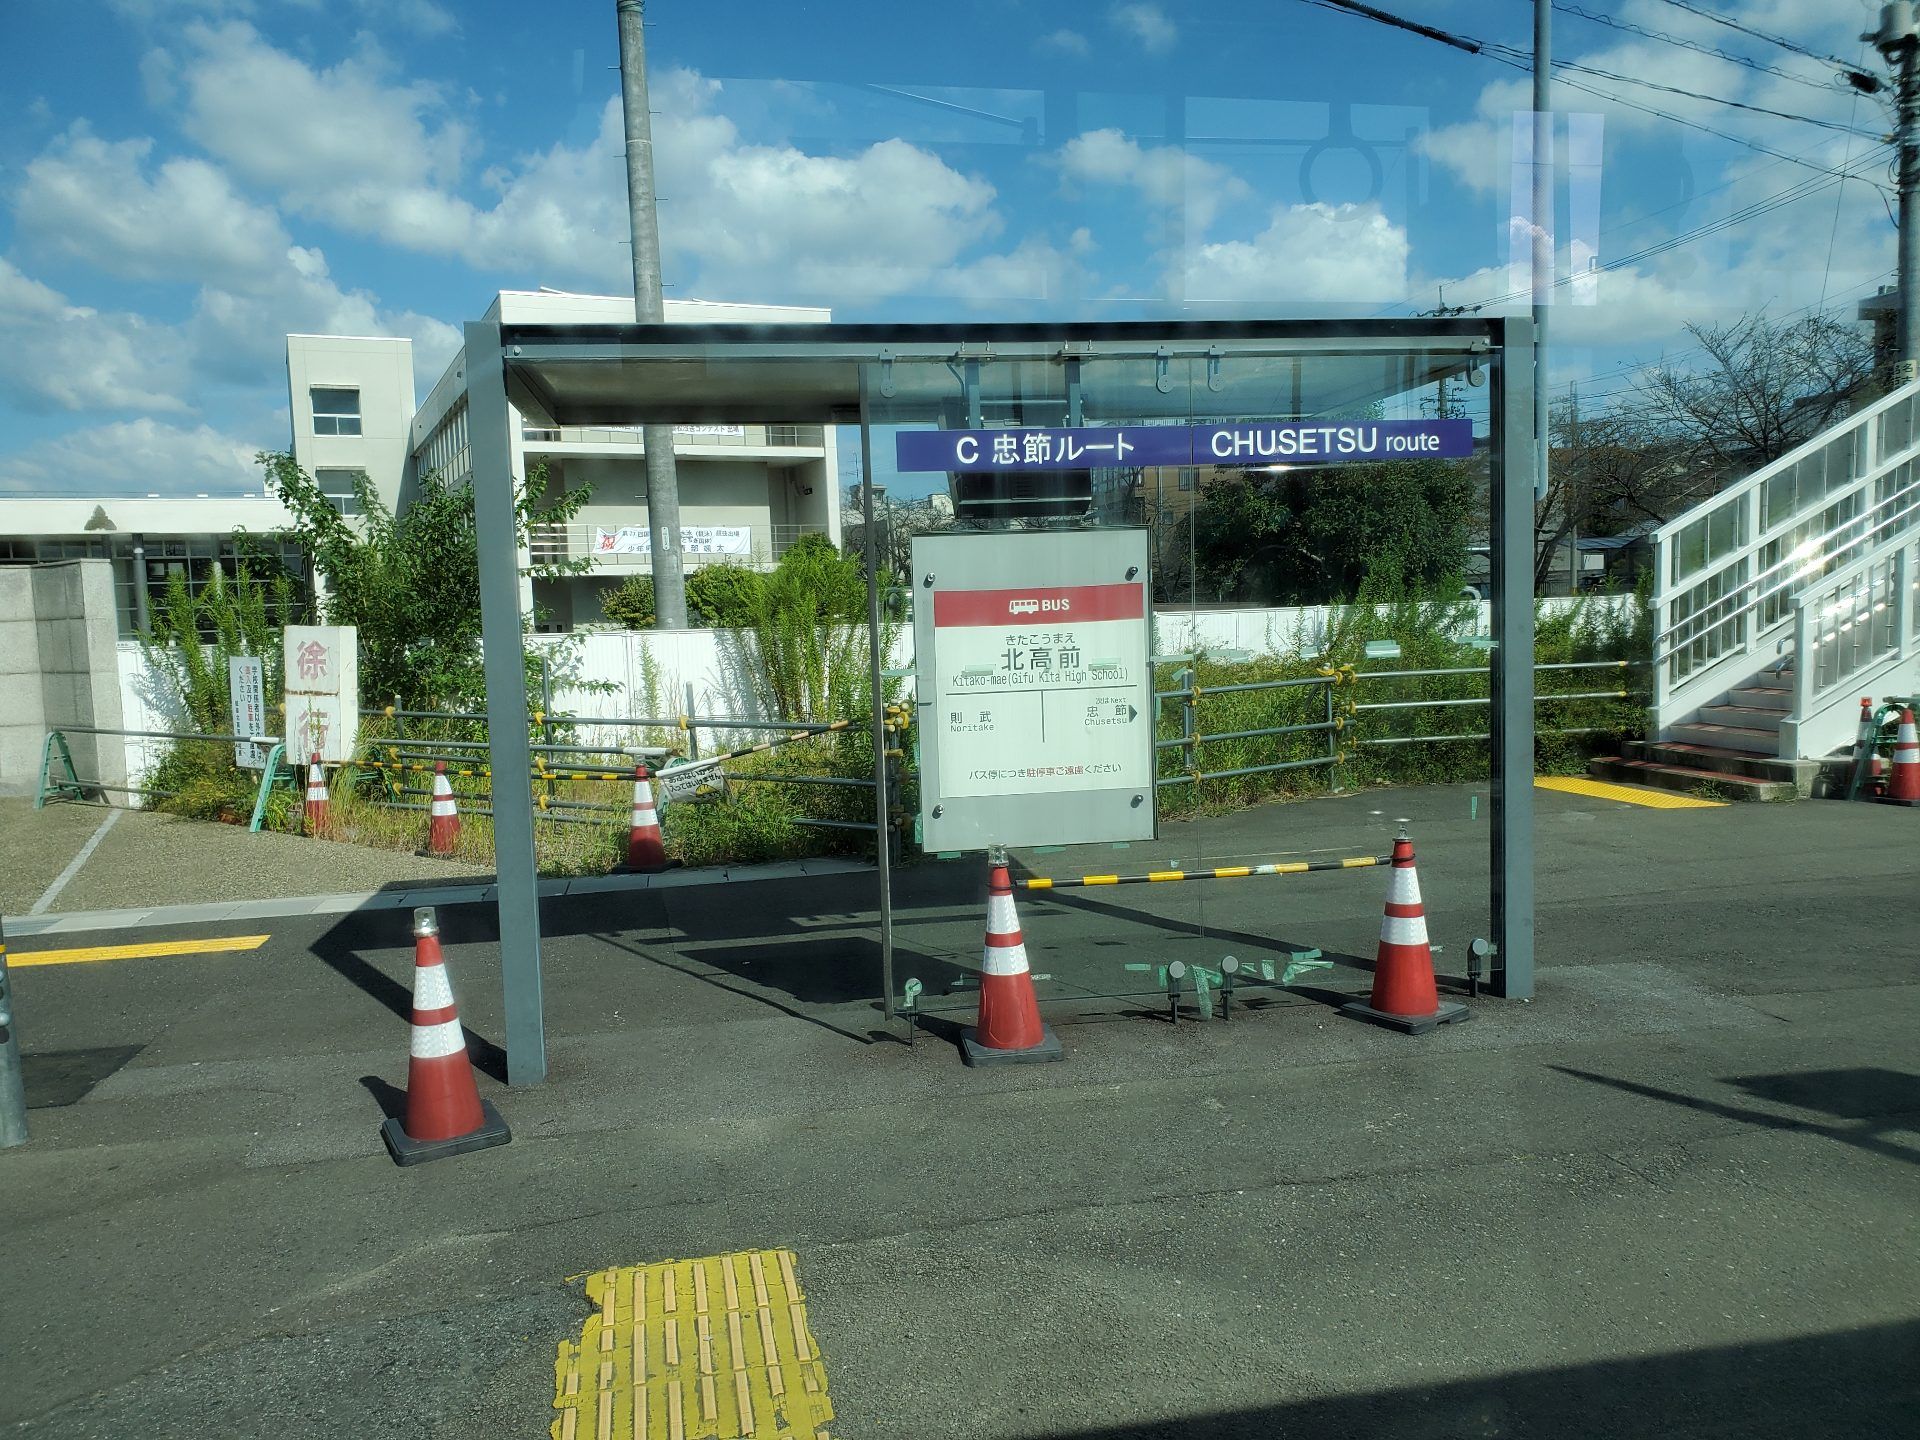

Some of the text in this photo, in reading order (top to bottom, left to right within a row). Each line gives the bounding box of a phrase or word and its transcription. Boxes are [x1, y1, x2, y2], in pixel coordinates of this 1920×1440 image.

[956, 427, 1440, 465] C 忠節ルート CHUSETSU route
[1041, 598, 1070, 611] BUS
[1005, 632, 1076, 646] きたこうまえ
[1000, 645, 1081, 671] 北高前
[952, 667, 1128, 687] Kitako-mae(Gifu Kita High School)
[950, 723, 994, 732] Noritake
[1084, 717, 1128, 726] Chusetsu
[968, 763, 1122, 780] バス停につき駐停車ご遠慮ください
[669, 772, 721, 793] 入ってはいけません
